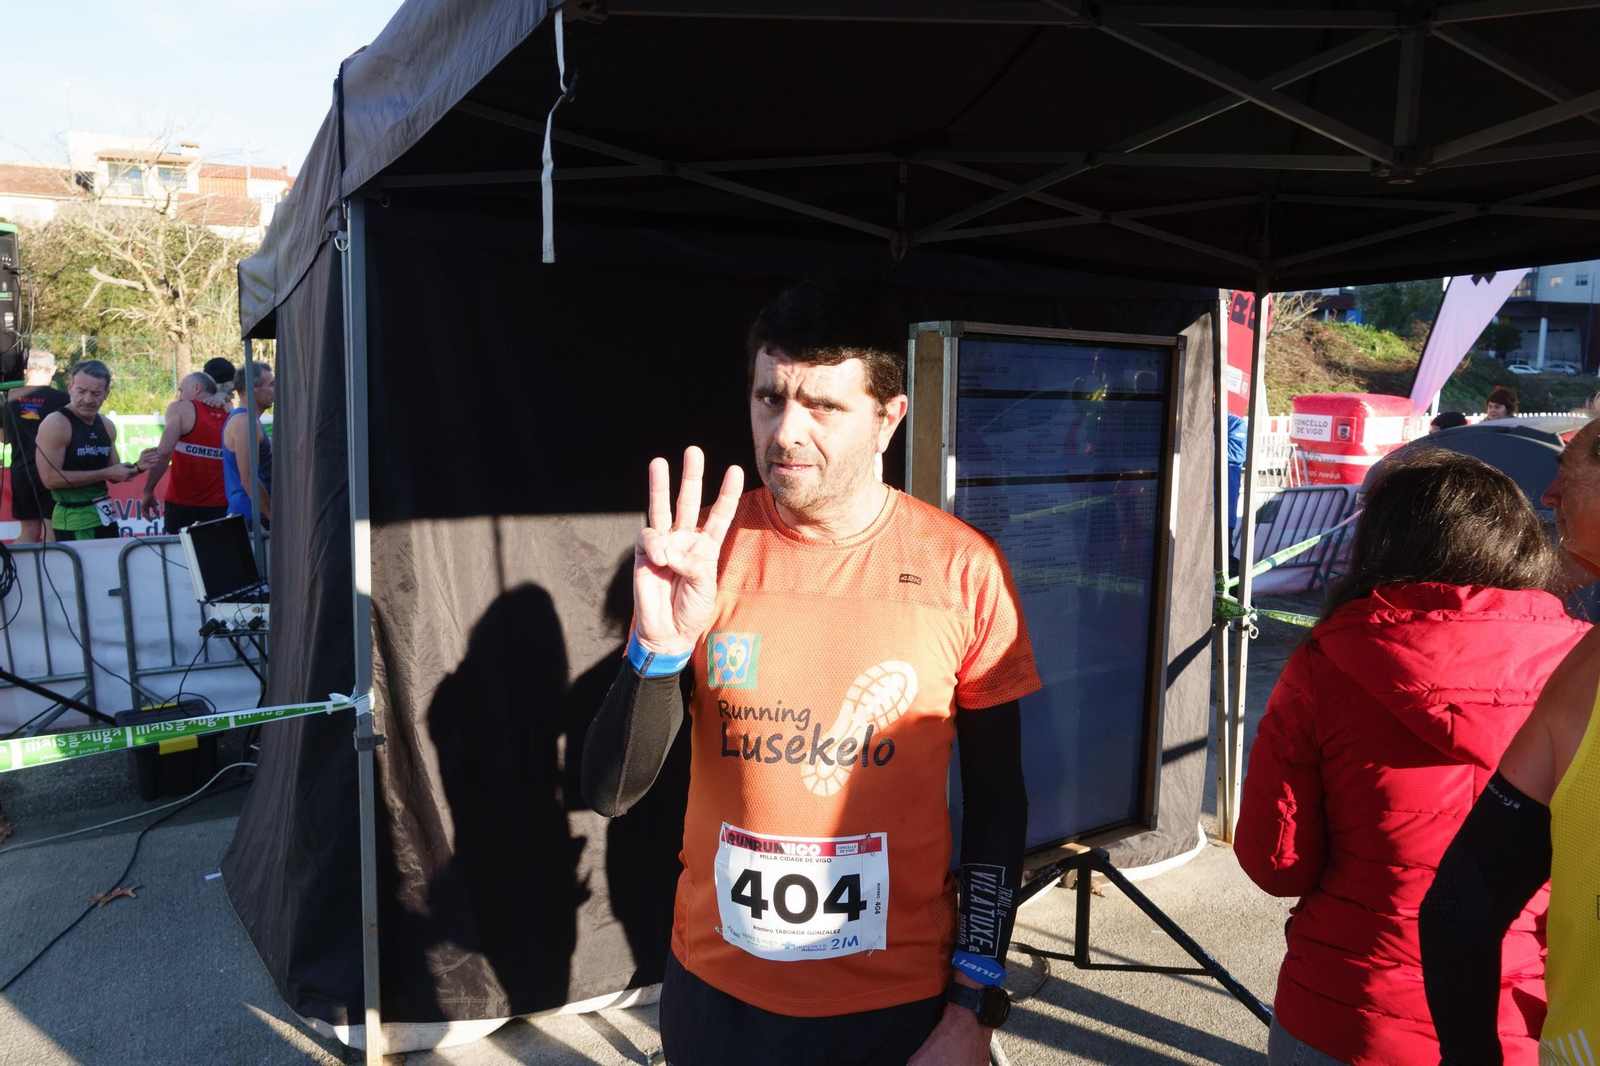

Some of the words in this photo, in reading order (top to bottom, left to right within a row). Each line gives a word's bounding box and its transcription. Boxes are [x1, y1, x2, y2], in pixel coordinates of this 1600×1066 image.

[1294, 418, 1329, 428] CONCELLO
[1296, 426, 1305, 434] DE
[1306, 427, 1324, 436] VIGO
[718, 699, 811, 730] Running
[721, 722, 896, 768] Lusekelo
[731, 868, 867, 924] 404
[970, 872, 996, 946] VILATUXE
[998, 887, 1013, 908] TRAIL
[753, 925, 774, 933] Ramiro
